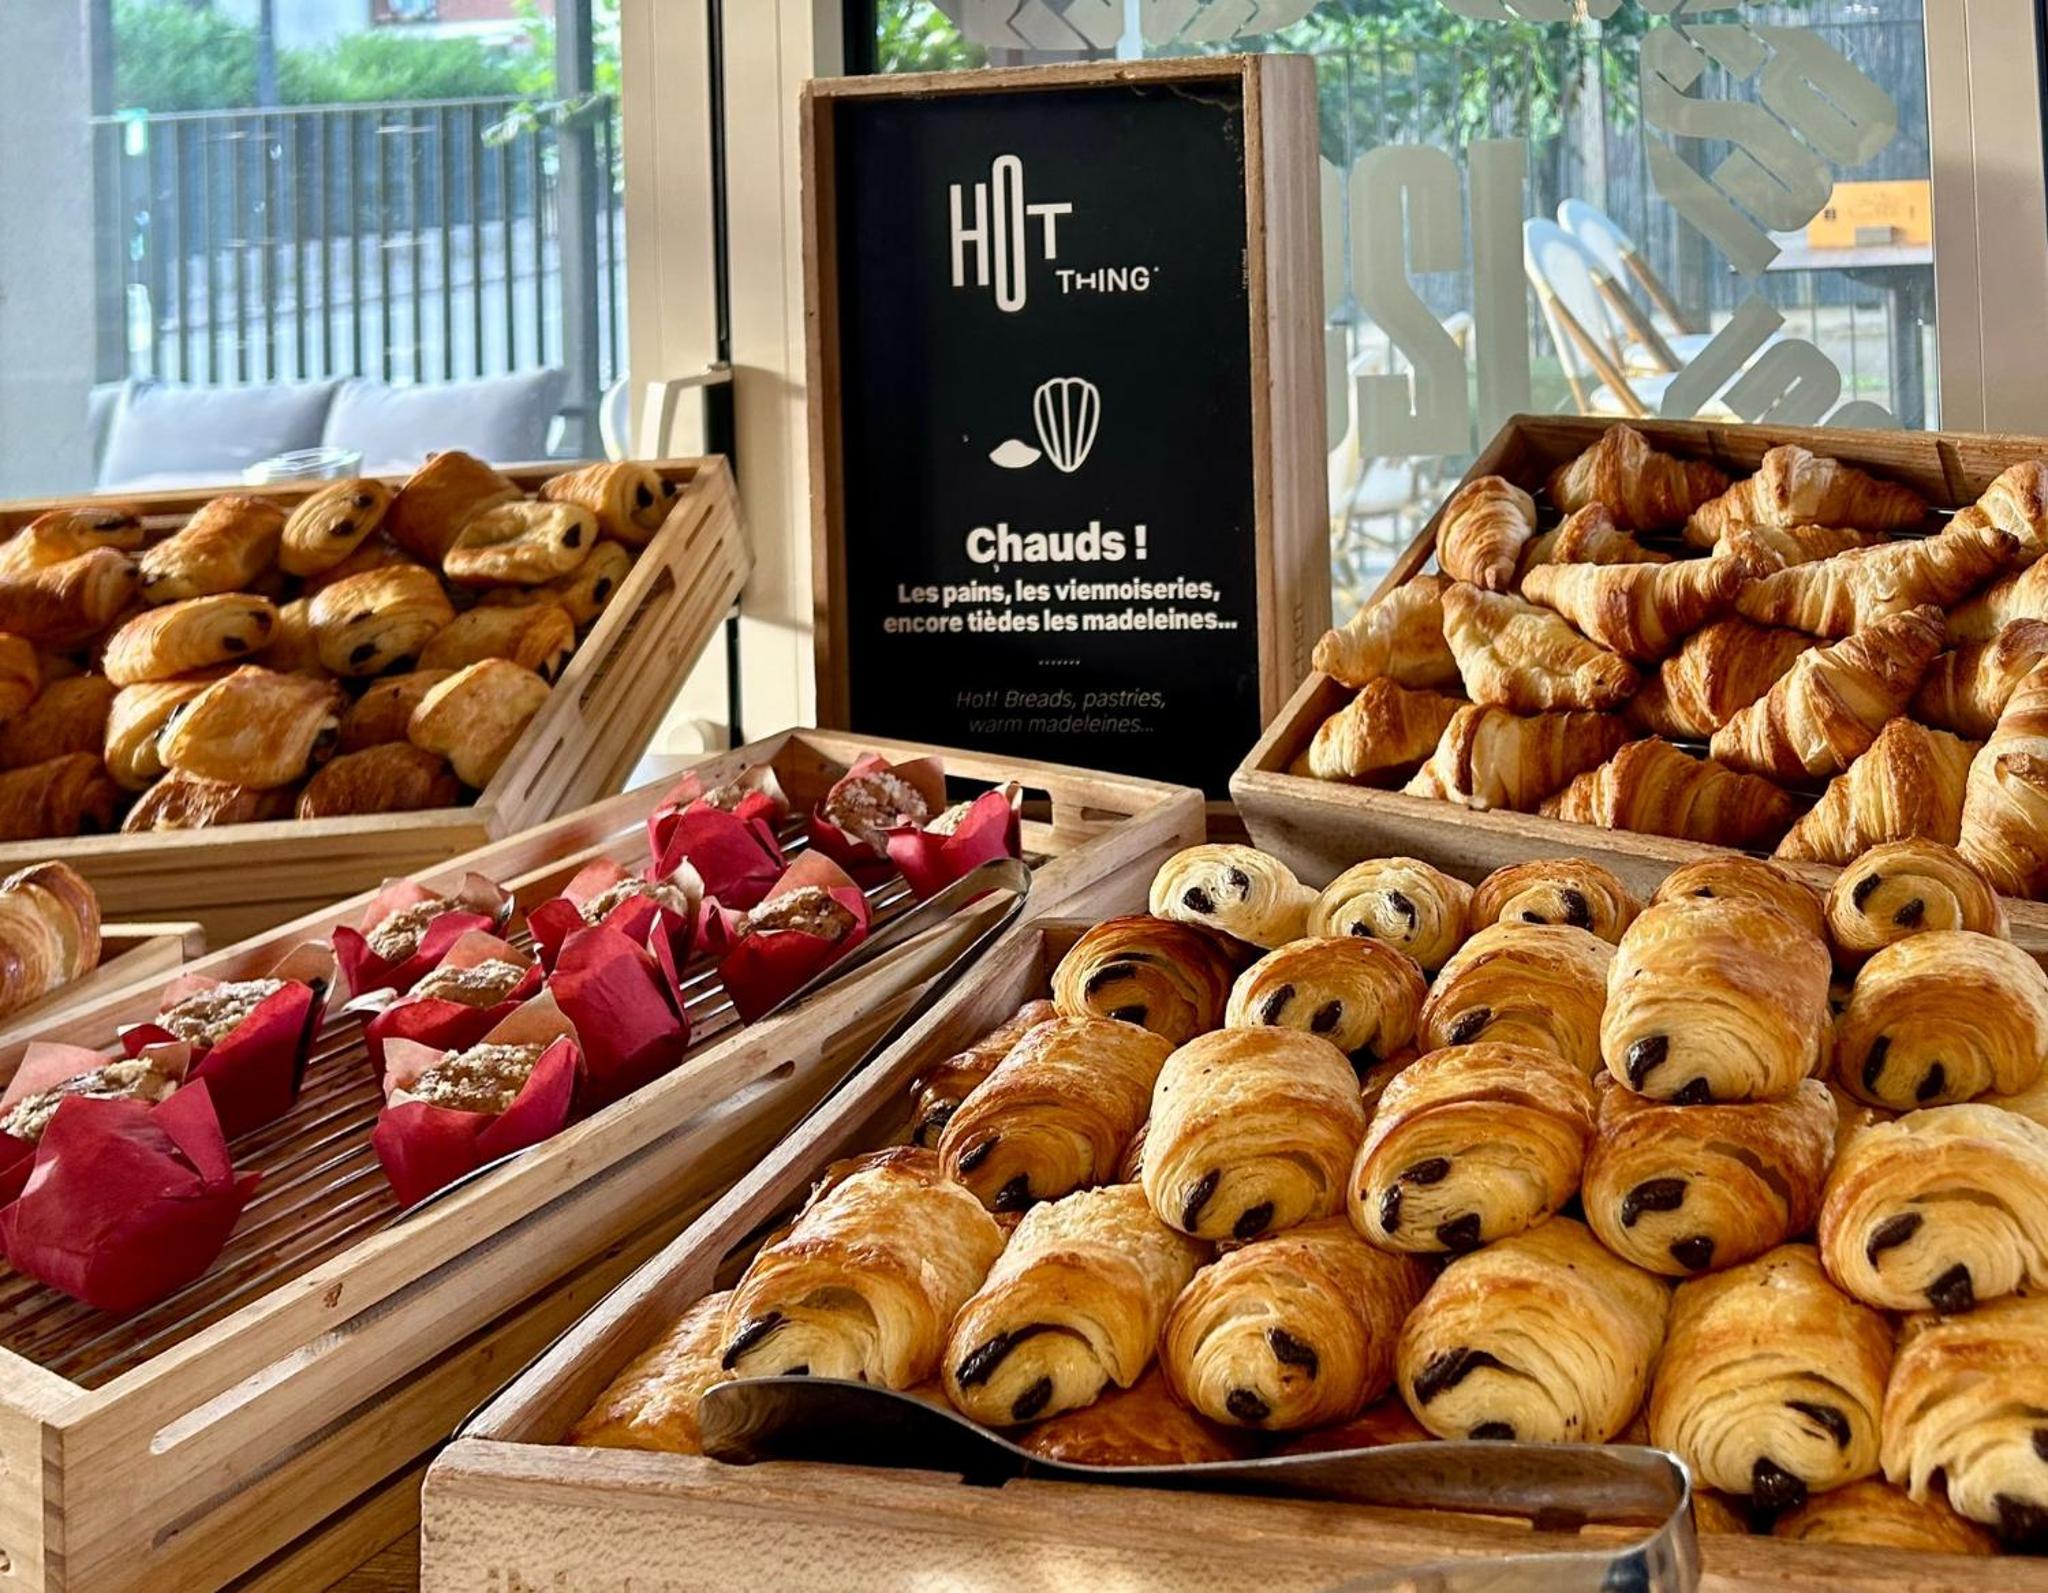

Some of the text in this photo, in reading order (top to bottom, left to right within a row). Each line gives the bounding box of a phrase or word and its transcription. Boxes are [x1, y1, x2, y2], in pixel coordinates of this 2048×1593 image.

[950, 155, 1073, 312] HOT
[1056, 266, 1150, 294] THING
[966, 521, 1126, 564] Chauds
[898, 577, 1221, 608] Les pains, les viennoiseries,
[883, 607, 1238, 633] encore tièdes les madeleines...
[956, 689, 1166, 710] Hot! Breads, pastries,
[968, 714, 1154, 733] warm madeleines...
